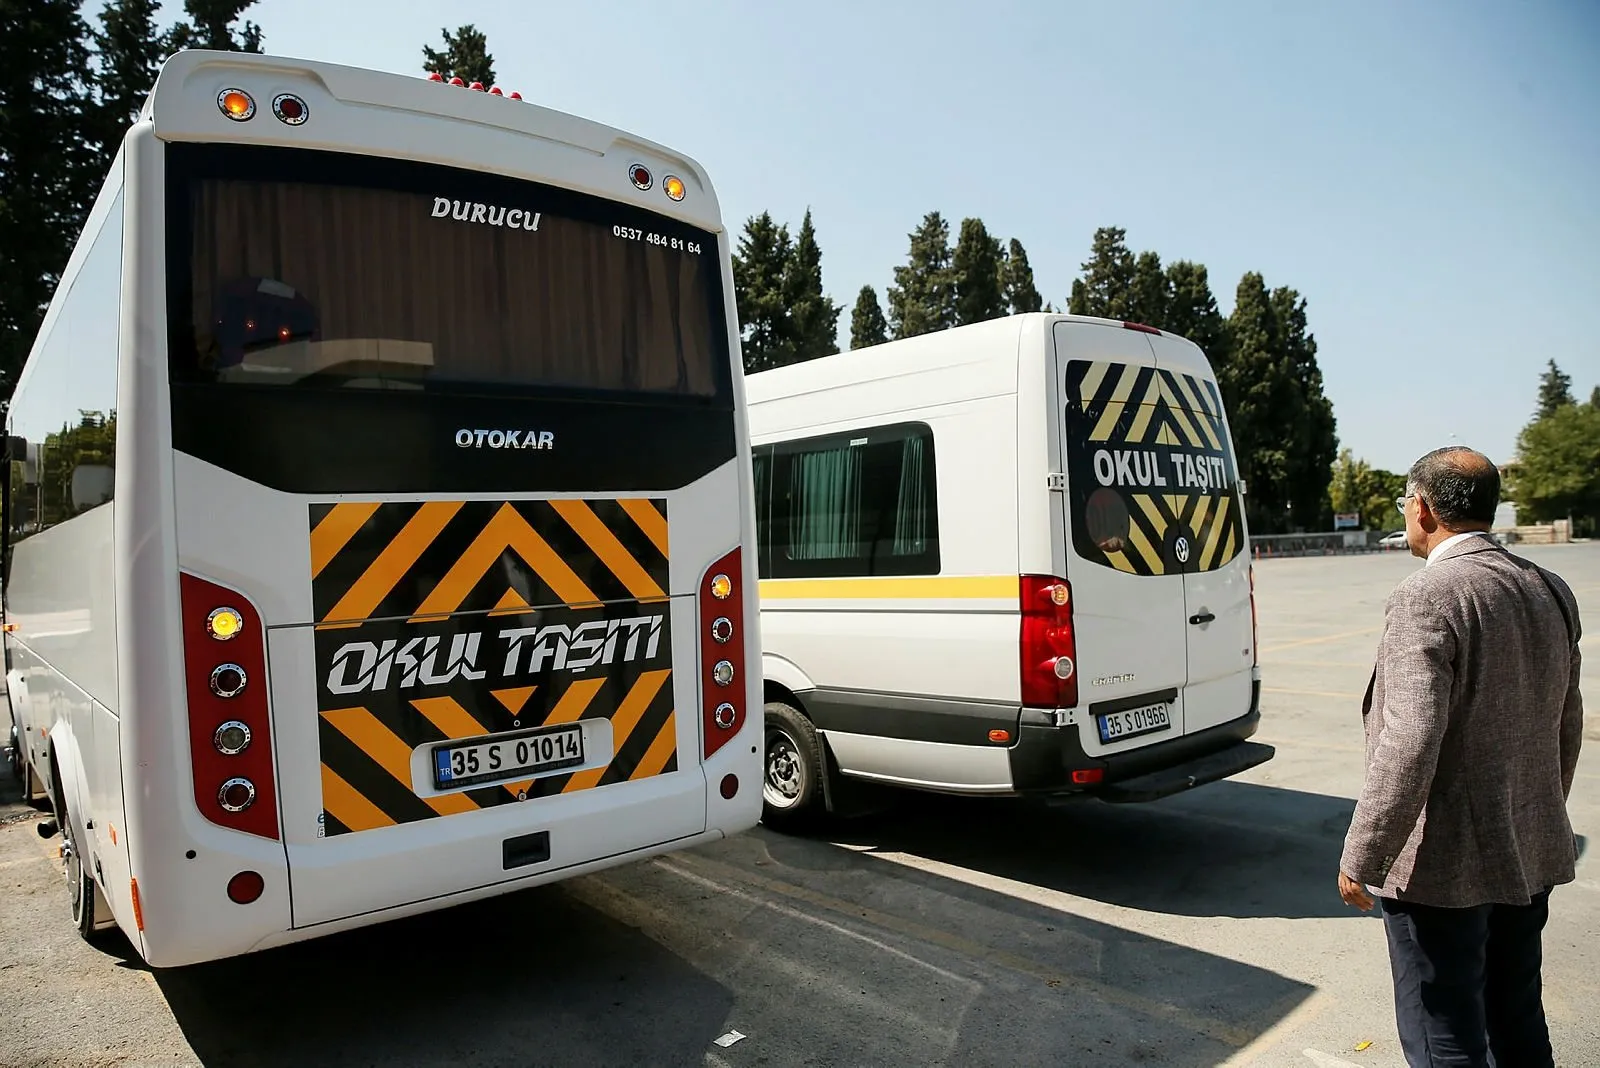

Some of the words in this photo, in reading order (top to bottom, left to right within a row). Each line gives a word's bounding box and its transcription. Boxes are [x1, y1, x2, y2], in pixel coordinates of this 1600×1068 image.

[431, 197, 541, 231] DURUCU
[613, 225, 642, 241] 0537
[646, 232, 668, 247] 484
[671, 238, 684, 251] 81
[687, 242, 701, 255] 64
[455, 428, 555, 449] OTOKAR
[1093, 449, 1167, 487] OKUL
[1170, 453, 1228, 494] TAŞITI
[326, 632, 486, 695] OKUL
[498, 614, 663, 673] TAŞITI
[1107, 715, 1122, 735] 35
[1125, 713, 1133, 731] S
[1134, 705, 1166, 729] 01966
[452, 748, 480, 776] 35
[488, 745, 502, 770] S
[516, 733, 578, 765] 01014
[440, 767, 451, 776] TR
